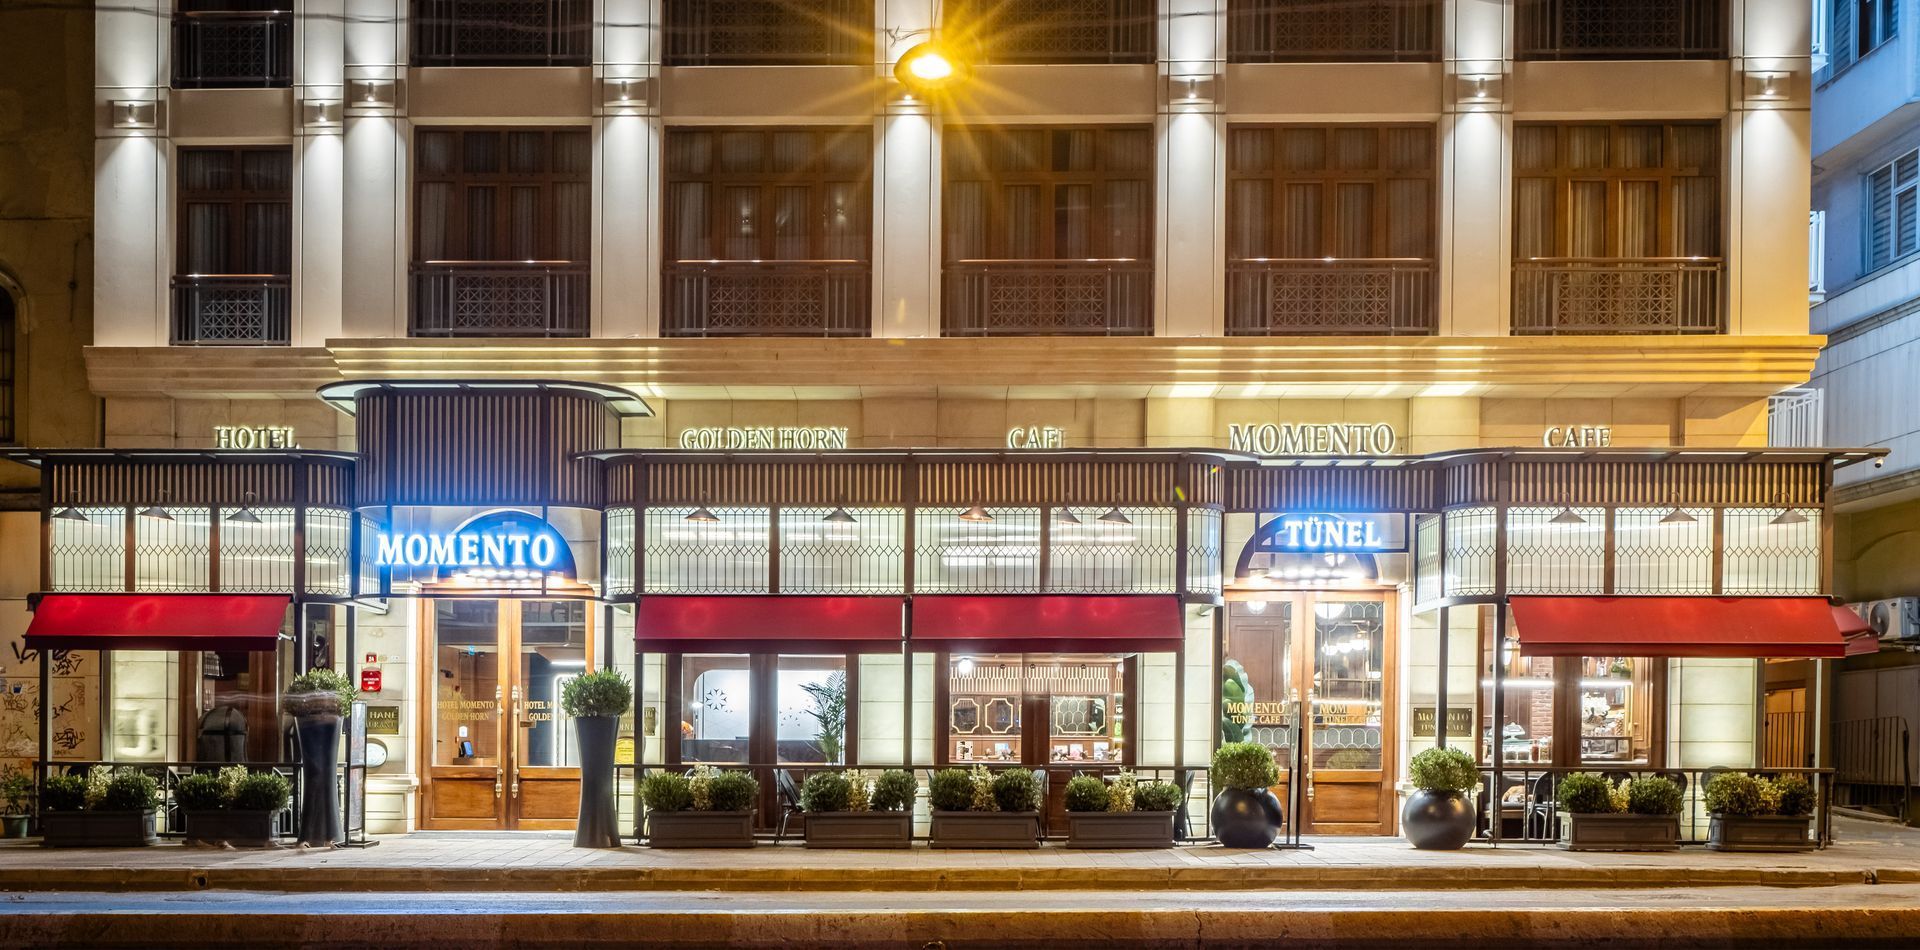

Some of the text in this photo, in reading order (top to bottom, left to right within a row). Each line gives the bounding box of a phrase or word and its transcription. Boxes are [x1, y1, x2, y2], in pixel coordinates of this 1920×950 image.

[215, 427, 298, 449] HOTEL
[680, 427, 848, 449] GOLDEN HORN
[1230, 423, 1395, 455] MOMENTO
[1543, 426, 1611, 448] CAFE
[1285, 516, 1381, 547] TÜNEL
[375, 533, 555, 567] MOMENTO
[437, 700, 494, 709] HOTEL MOMENTO
[524, 700, 546, 709] HOTEL
[1227, 702, 1285, 714] MOMENTO
[470, 712, 489, 720] HORN
[528, 712, 555, 720] GOLDE
[1259, 715, 1281, 724] CAFE
[1418, 712, 1469, 721] MONTO
